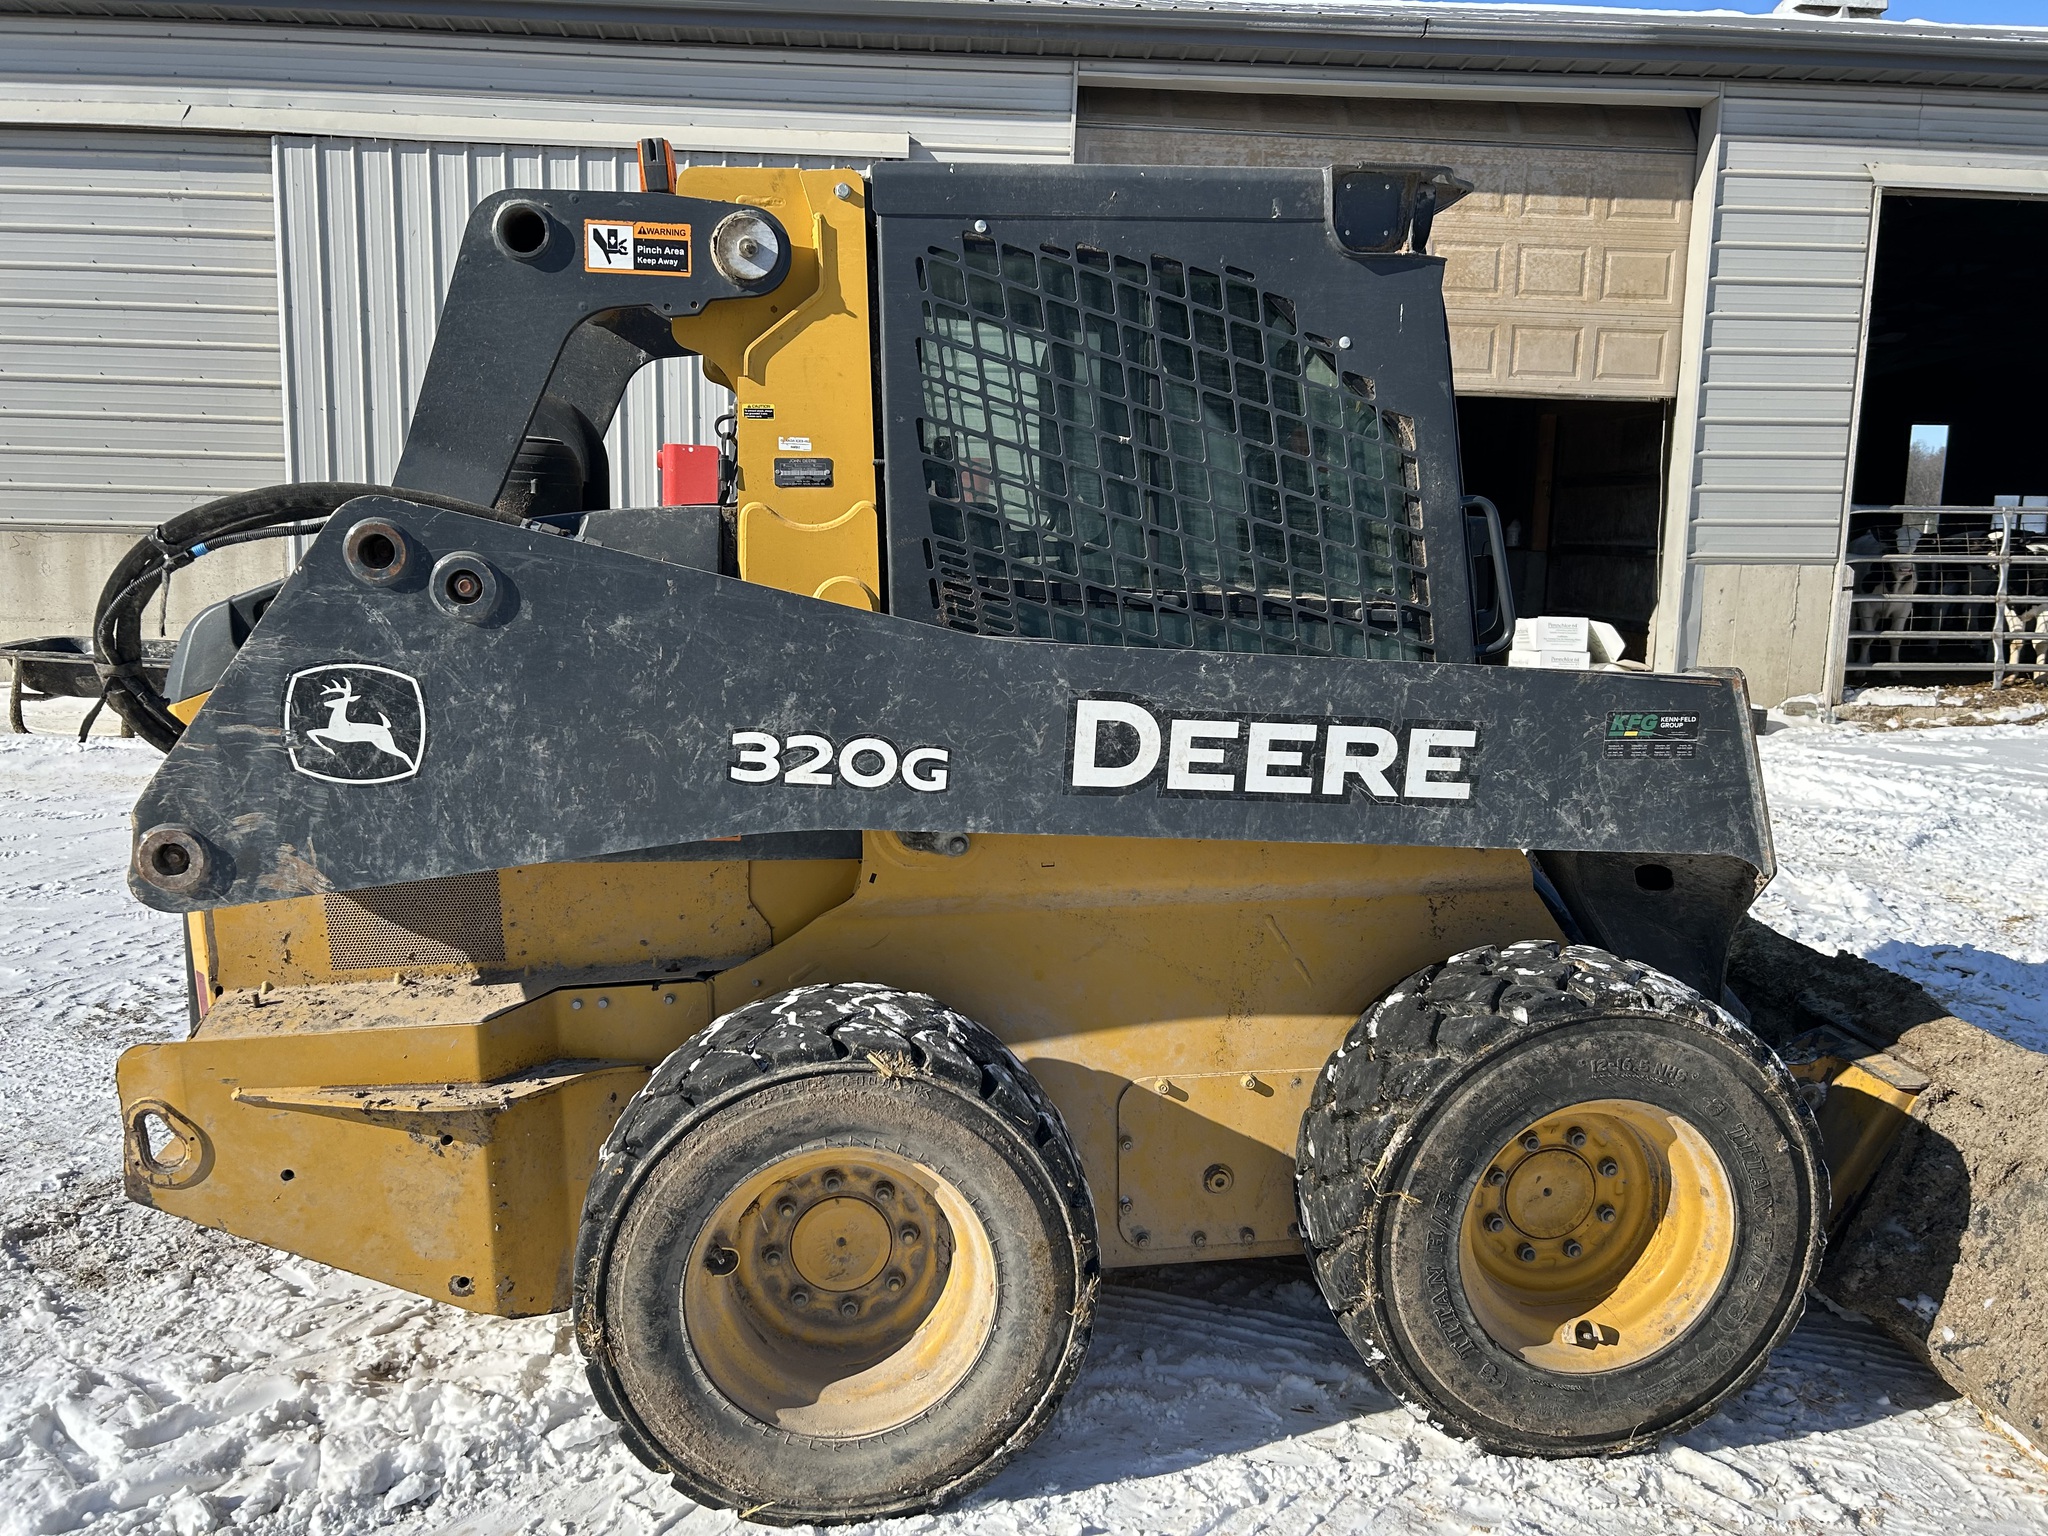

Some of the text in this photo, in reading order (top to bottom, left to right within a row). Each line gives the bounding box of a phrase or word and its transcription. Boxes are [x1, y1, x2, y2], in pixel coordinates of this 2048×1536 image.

[646, 228, 686, 237] WARNING
[637, 245, 685, 256] Pinch Area
[637, 256, 679, 267] Keep Away
[1610, 714, 1658, 731] KFG
[730, 731, 949, 792] 320G
[1072, 699, 1477, 800] DEERE
[1590, 1057, 1651, 1073] 12-16.5
[1653, 1062, 1688, 1083] NHS
[1724, 1122, 1776, 1219] TITAN
[1426, 1266, 1475, 1360] TITAN
